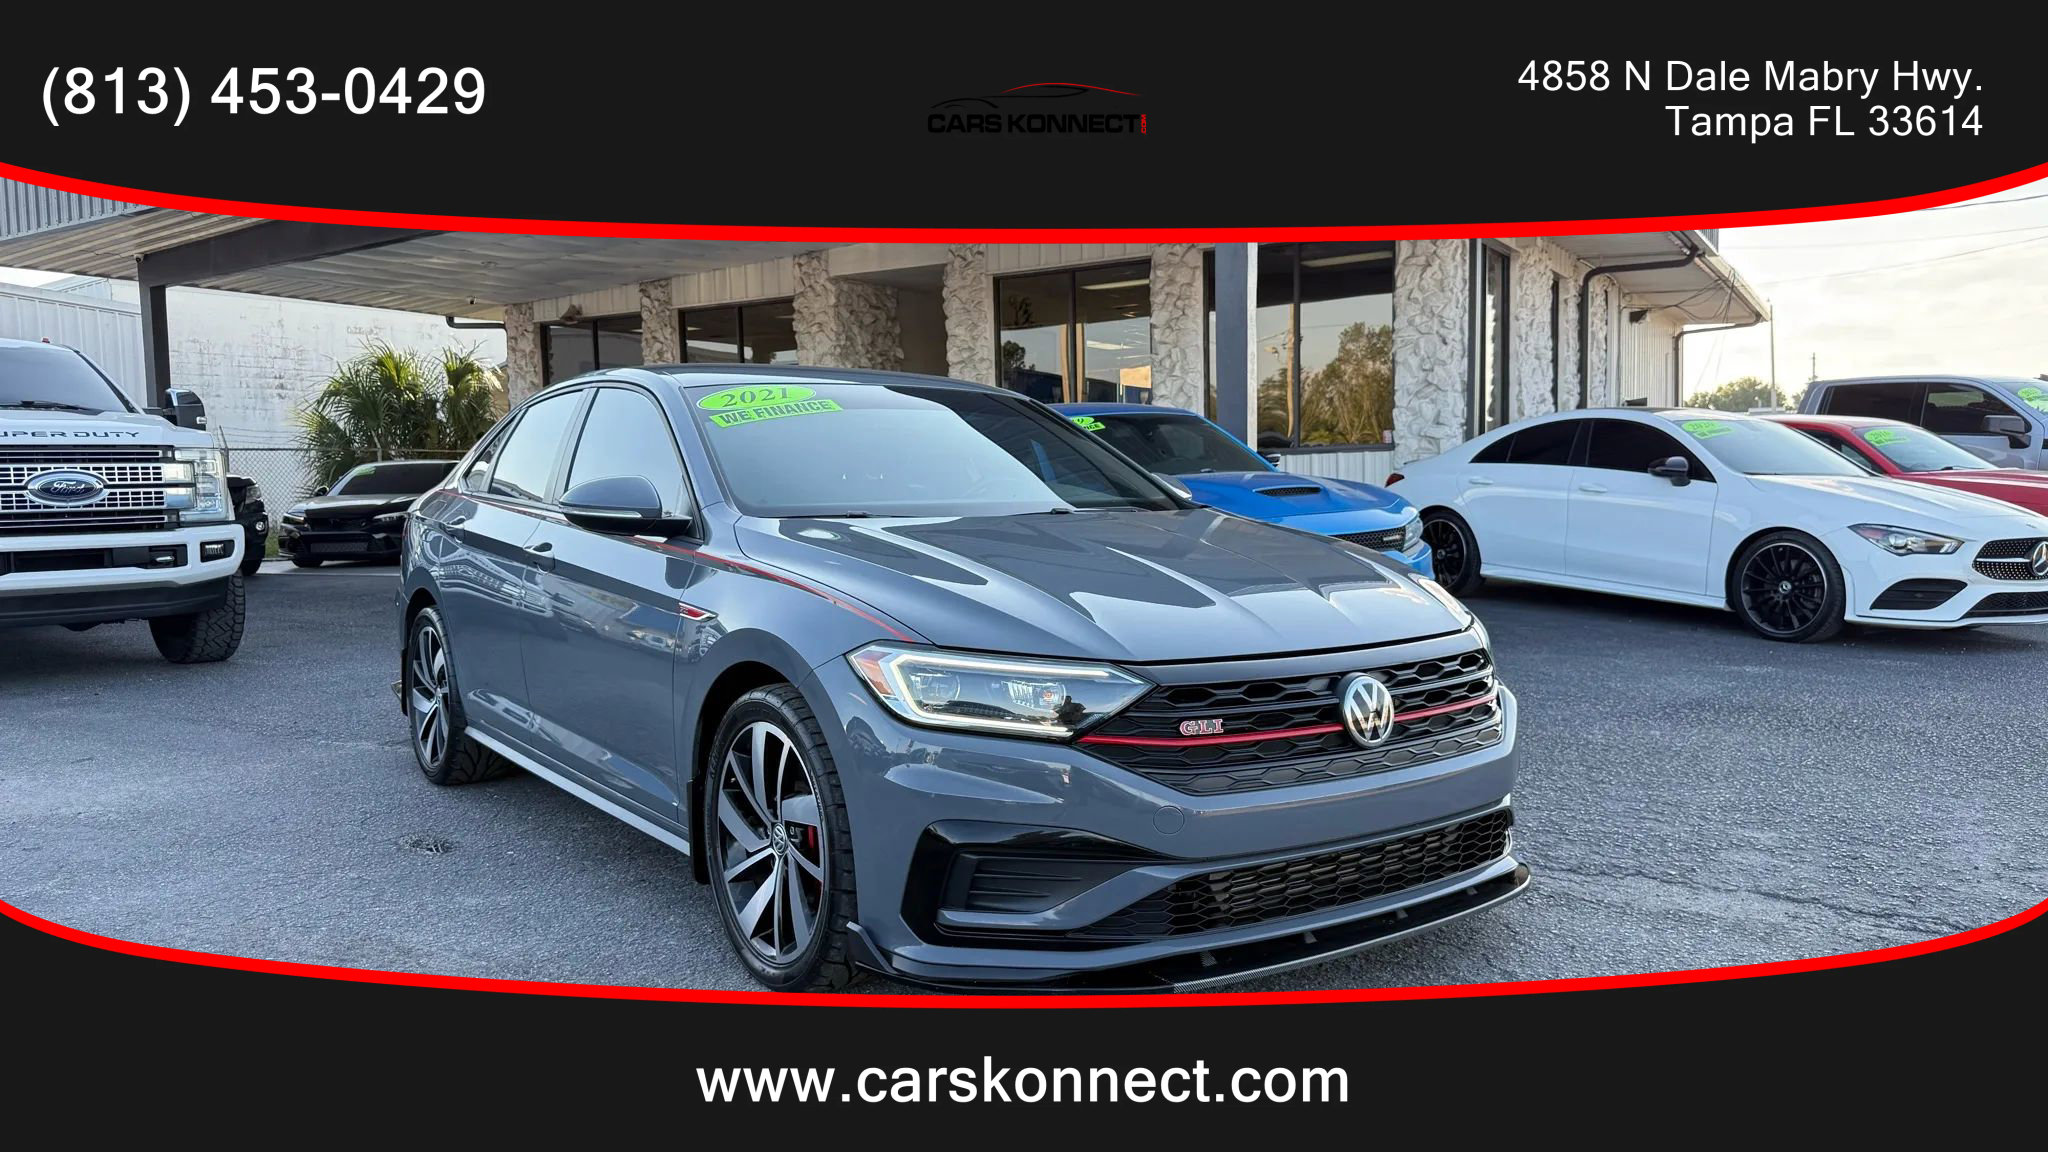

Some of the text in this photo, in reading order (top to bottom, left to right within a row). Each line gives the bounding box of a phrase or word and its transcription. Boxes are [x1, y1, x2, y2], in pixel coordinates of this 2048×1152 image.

[720, 387, 793, 408] 2021
[719, 400, 833, 425] WE FINANCE
[50, 480, 85, 495] Ford
[1179, 718, 1224, 736] GLI
